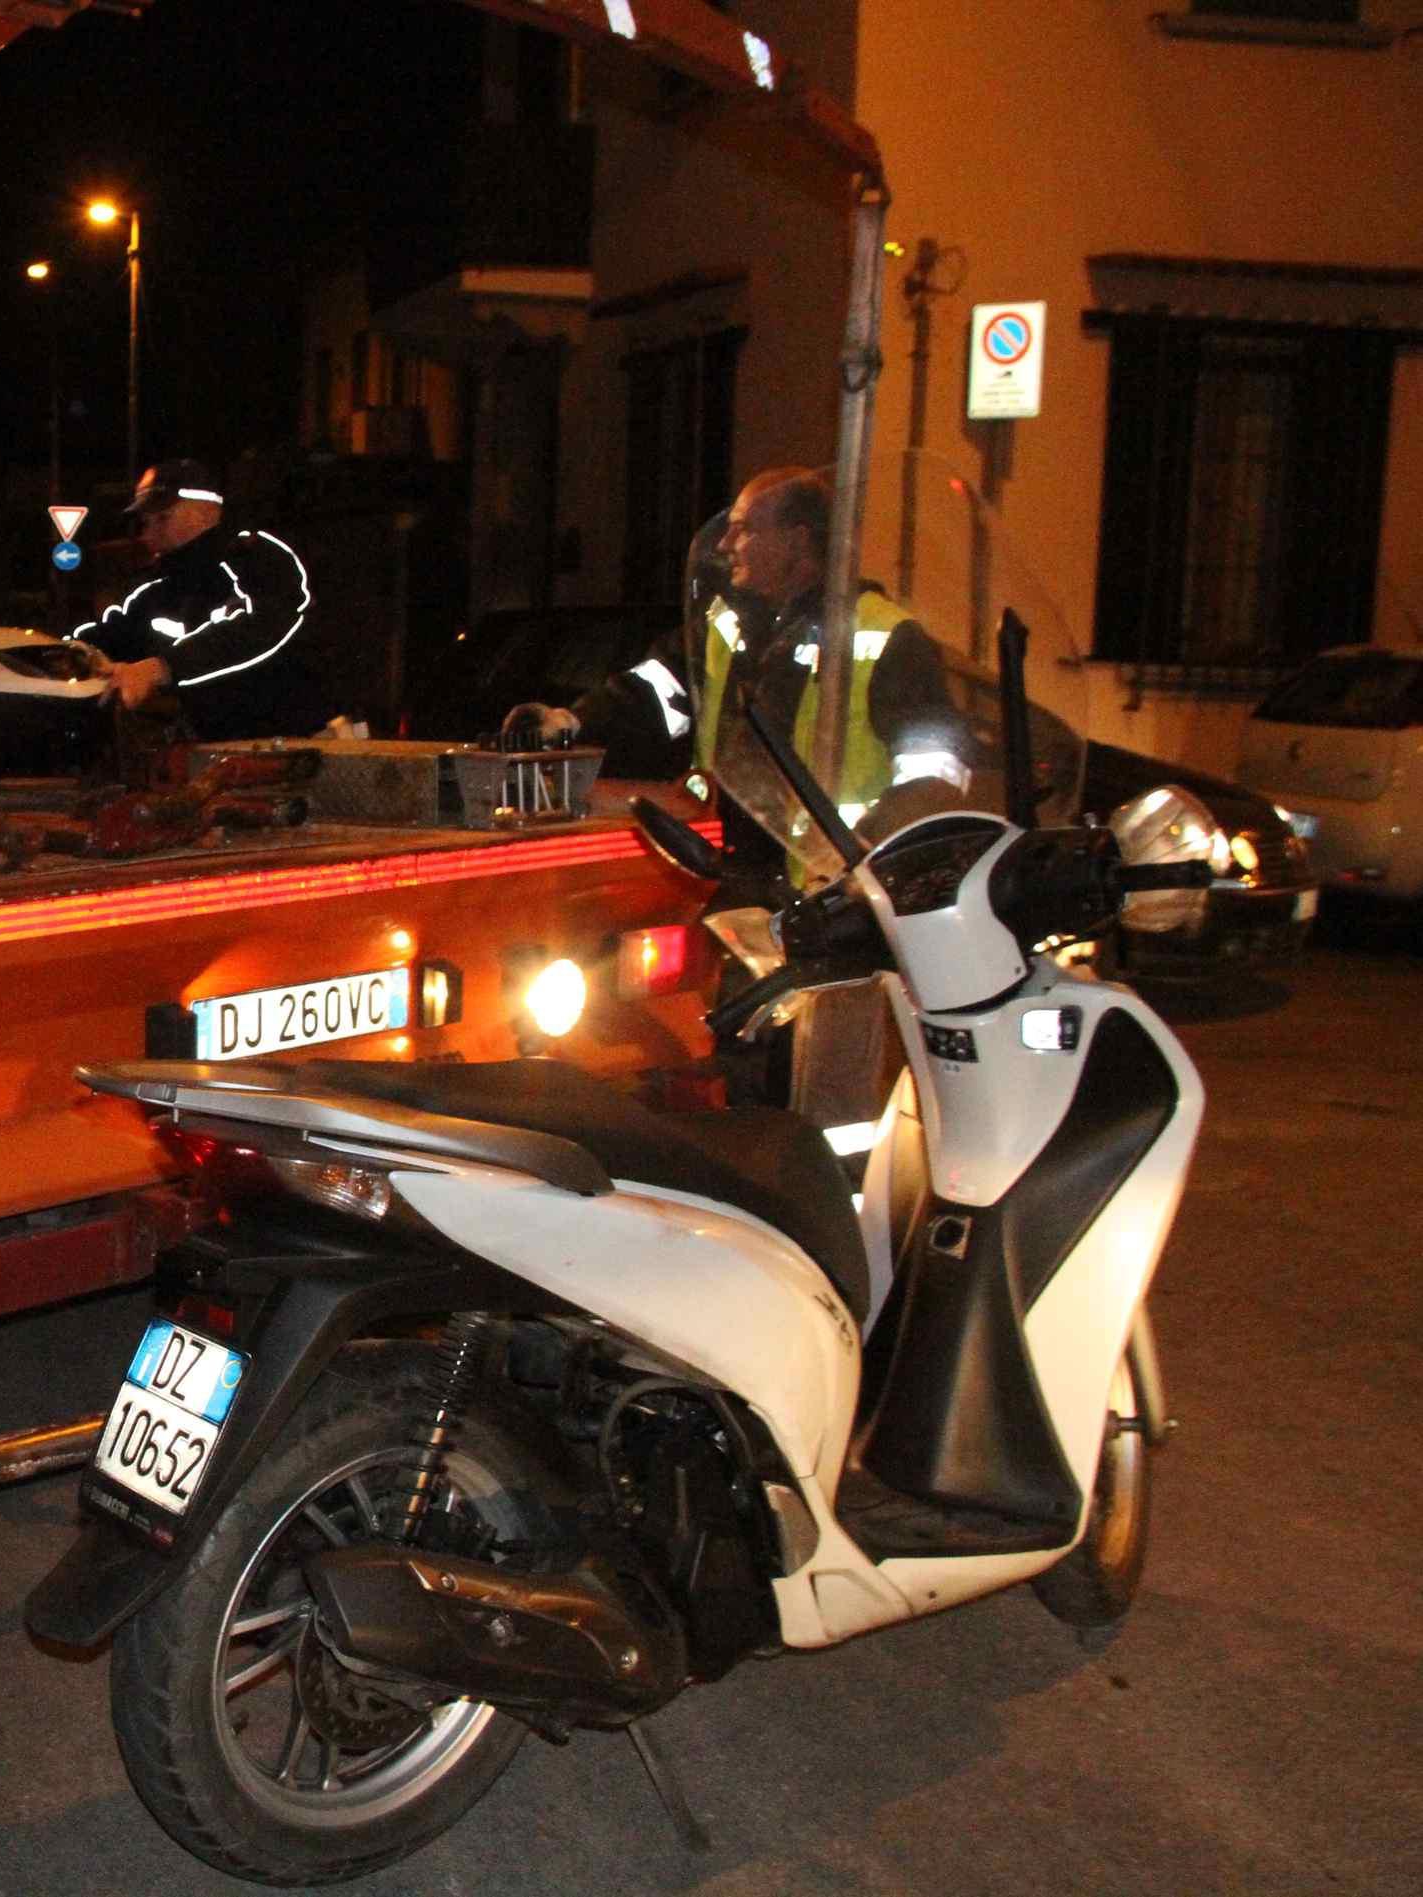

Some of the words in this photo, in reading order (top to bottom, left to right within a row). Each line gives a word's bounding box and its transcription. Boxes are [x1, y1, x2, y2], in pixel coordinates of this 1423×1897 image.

[220, 998, 262, 1053] DJ
[279, 978, 384, 1042] 260VC
[151, 1330, 207, 1401] DZ
[108, 1400, 208, 1500] 10652
